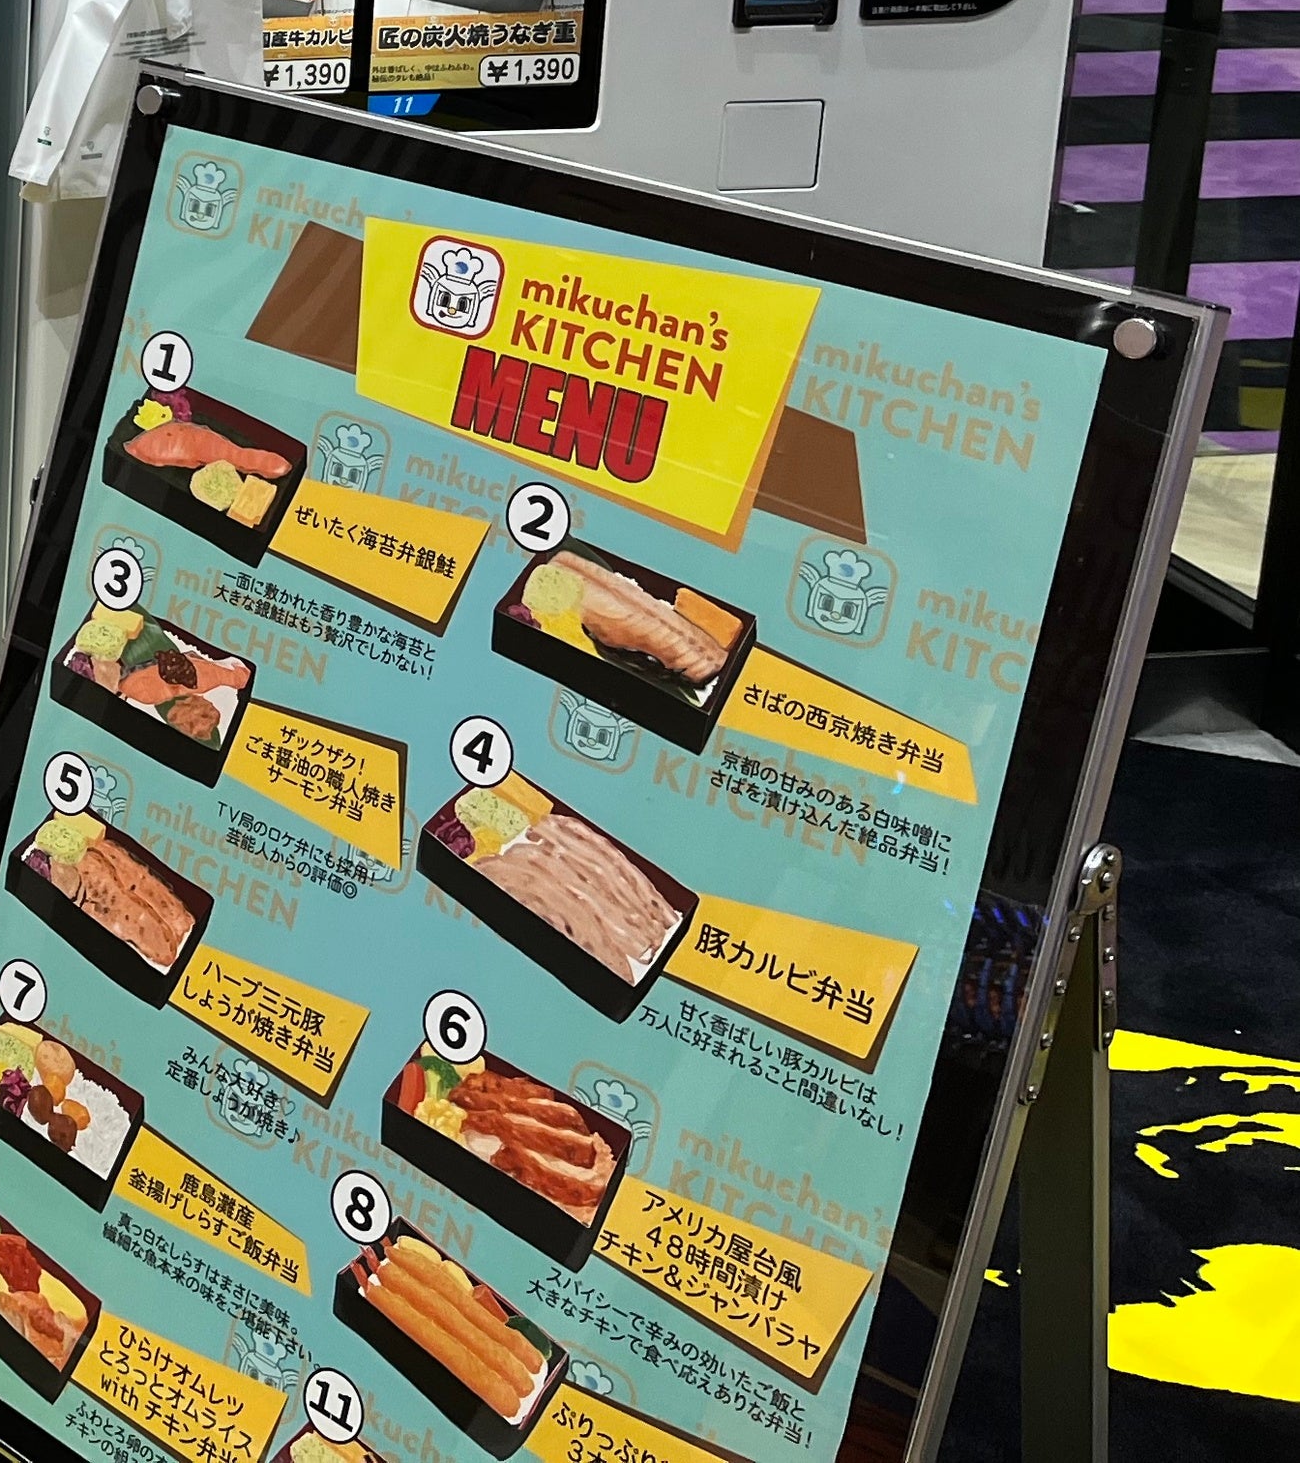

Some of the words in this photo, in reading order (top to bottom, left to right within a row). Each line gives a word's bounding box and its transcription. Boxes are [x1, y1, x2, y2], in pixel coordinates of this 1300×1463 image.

[379, 22, 577, 50] 匠の炭火焼うなぎ重
[393, 96, 413, 113] 11
[509, 309, 724, 403] KITCHEN
[520, 274, 729, 353] mikuchan's
[450, 344, 669, 484] MENU
[294, 505, 458, 580] ぜいたく海苔弁銀鮭
[520, 495, 555, 541] 2
[223, 569, 436, 662] 一面に敷かれた香り豊かな海苔と
[742, 682, 944, 774] さばの西京焼き弁当
[245, 737, 397, 814] ごま醤油の職人焼き
[267, 766, 365, 823] サーモン弁当
[720, 750, 952, 854] 京都の甘みのある白味噌に
[203, 960, 327, 1036] ハーブ三元豚
[694, 923, 875, 1025] 豚カルビ弁当
[181, 976, 335, 1074] しょうが焼き弁当
[127, 1168, 299, 1283] 釜揚げしらすご飯弁当
[181, 1173, 255, 1231] 鹿島灘産
[643, 1190, 803, 1294] アメリカ屋台風
[99, 1340, 253, 1458] とろっとオムライス
[118, 1325, 244, 1417] ひらけオムレツ
